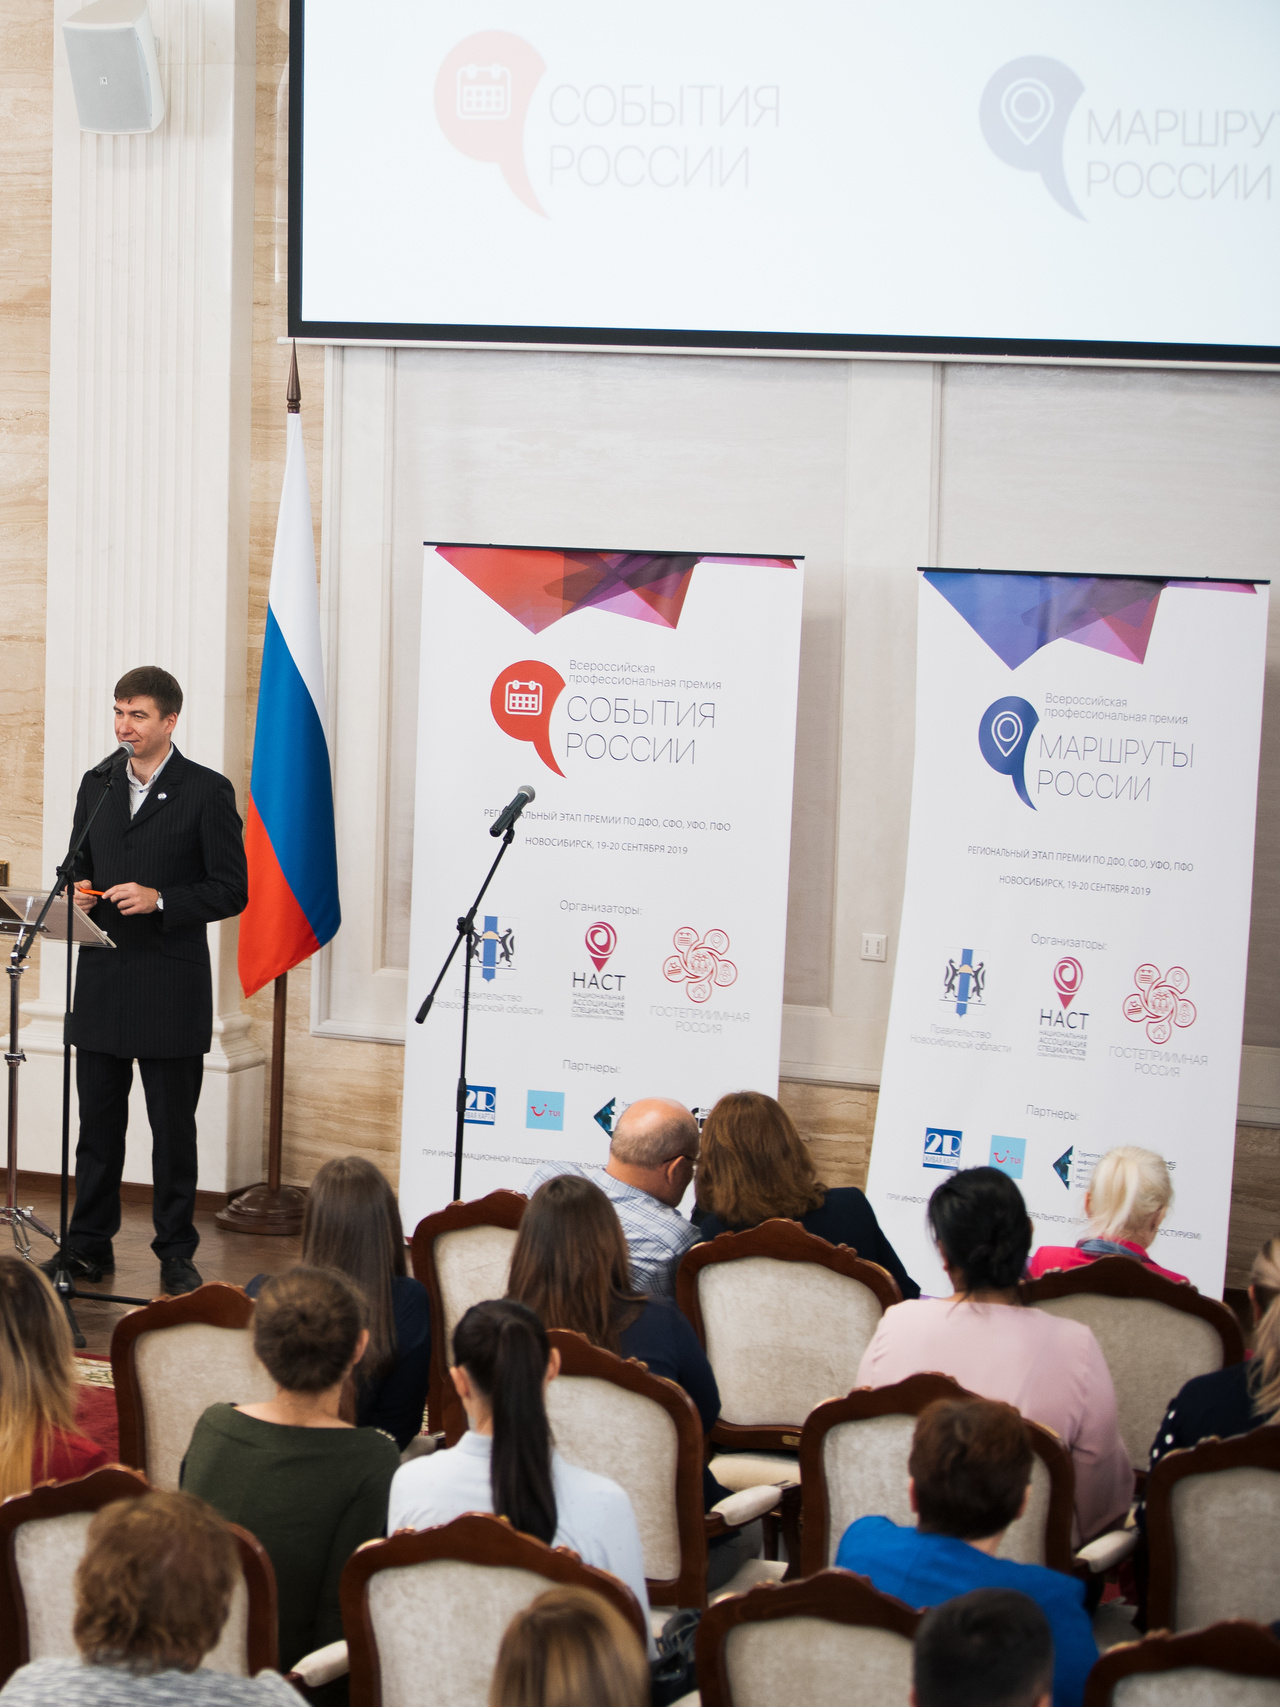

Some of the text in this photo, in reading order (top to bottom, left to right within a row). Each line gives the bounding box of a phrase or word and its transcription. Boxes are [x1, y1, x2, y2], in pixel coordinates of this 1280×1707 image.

[548, 83, 780, 128] СОБЫТИЯ
[1087, 108, 1280, 149] МАРШРУ
[549, 144, 749, 189] РОССИИ
[1087, 161, 1272, 201] РОССИИ
[569, 659, 656, 673] Всероссийская
[568, 674, 722, 690] профессиональная премия
[1045, 692, 1128, 707] Всероссийская
[567, 695, 716, 729] СОБЫТИЯ
[1044, 707, 1189, 725] профессиональная премия
[566, 732, 695, 765] РОССИИ
[1039, 733, 1194, 768] МАРШРУТЫ
[1037, 769, 1151, 802] РОССИИ
[483, 809, 732, 832] РЕГАЛЬНЫЙ ЭТАП ПРЕМИИ ПО ДФО, СФО, УФО, ПФО
[525, 836, 689, 855] НОВОСИБИРСК, 19-20 СЕНТЯБРЯ 2019
[967, 845, 1194, 872] РЕГИОНАЛЬНЫЙ ЭТАП ПРЕМИИ ПО ДФО, СФО, УФО, ПФО
[999, 875, 1151, 896] НОВОСИБИРСК, 19-20 СЕНТЯБРЯ 2019
[559, 899, 643, 916] Организаторы:
[1030, 933, 1108, 951] Организаторы:
[572, 971, 626, 991] НАСТ
[675, 1020, 723, 1034] РОССИЯ
[1039, 1008, 1090, 1030] НАСТ
[1109, 1045, 1208, 1066] ГОСТЕПРИИМНАЯ
[562, 1059, 621, 1075] Партнеры:
[1134, 1062, 1180, 1077] РОССИЯ
[548, 1109, 561, 1117] TUI
[1025, 1104, 1080, 1122] Партнеры:
[924, 1133, 961, 1156] 2R
[1010, 1156, 1022, 1164] TUI
